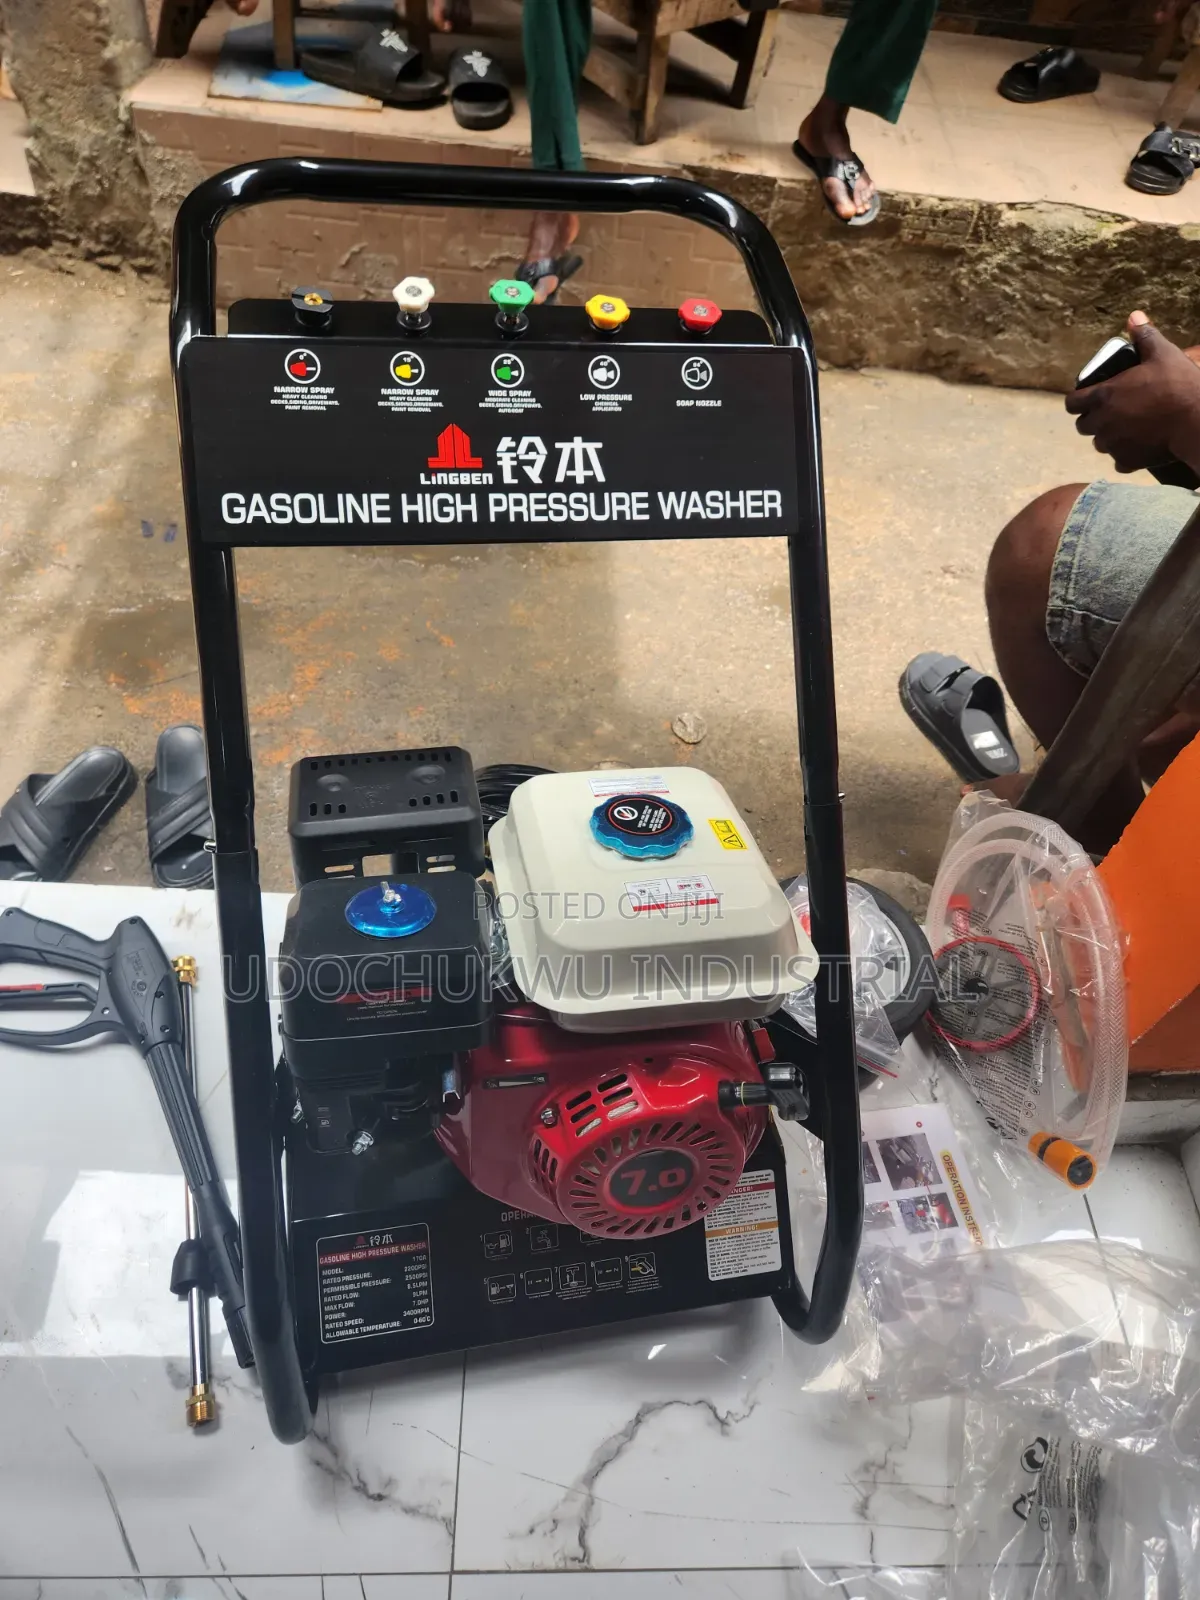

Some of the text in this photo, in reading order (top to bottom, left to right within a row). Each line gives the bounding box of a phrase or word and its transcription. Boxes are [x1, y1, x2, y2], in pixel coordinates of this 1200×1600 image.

[273, 386, 335, 395] NARROW SPRAY
[381, 388, 414, 396] NARROW
[496, 435, 606, 485] 铃本
[221, 489, 782, 524] GASOLINE HIGH PRESSURE WASHER
[620, 1167, 686, 1196] 7.0
[942, 1154, 966, 1205] OPERATION
[725, 1225, 758, 1234] WARNING!
[319, 1253, 350, 1265] GASOLINE
[351, 1250, 367, 1260] HIGH
[368, 1245, 399, 1257] PRESSURE
[400, 1241, 427, 1252] WASHER
[322, 1267, 344, 1276] MODEL:
[322, 1276, 341, 1285] RATED
[341, 1272, 372, 1282] PRESSURE:
[323, 1282, 361, 1294] PERMISSIBLE
[361, 1277, 392, 1288] PRESSURE:
[323, 1294, 342, 1303] RATED
[343, 1291, 360, 1300] FLOW:
[324, 1303, 338, 1312] MAX
[338, 1301, 356, 1310] FLOW:
[324, 1312, 347, 1321] POWER:
[325, 1321, 344, 1330] RATED
[344, 1317, 365, 1327] SPEED:
[325, 1327, 360, 1339] ALLOWABLE
[359, 1320, 403, 1333] TEMPERATURE:
